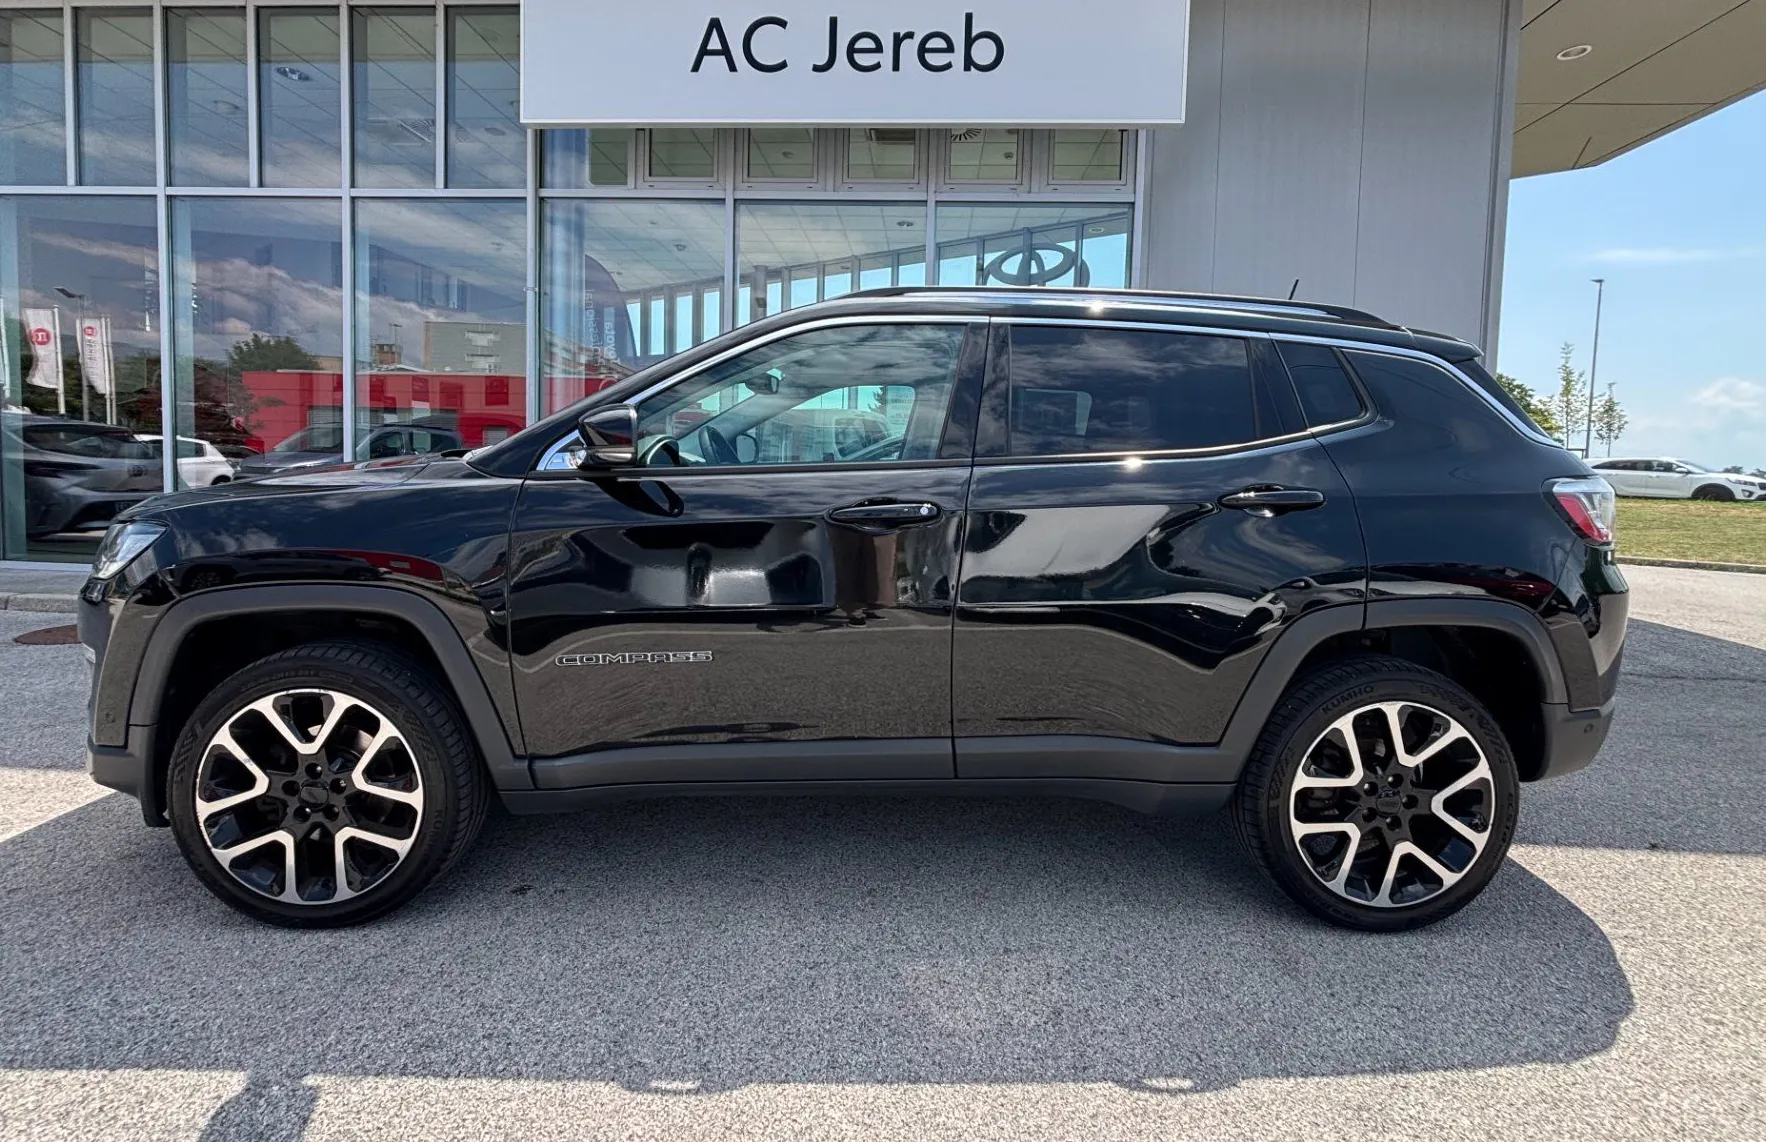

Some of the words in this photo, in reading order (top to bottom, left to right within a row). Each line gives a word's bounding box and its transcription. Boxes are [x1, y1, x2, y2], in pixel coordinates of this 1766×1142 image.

[690, 15, 788, 73] AC
[811, 11, 1005, 73] Jereb
[555, 650, 713, 667] COMPASS
[1321, 685, 1374, 714] KUMHO
